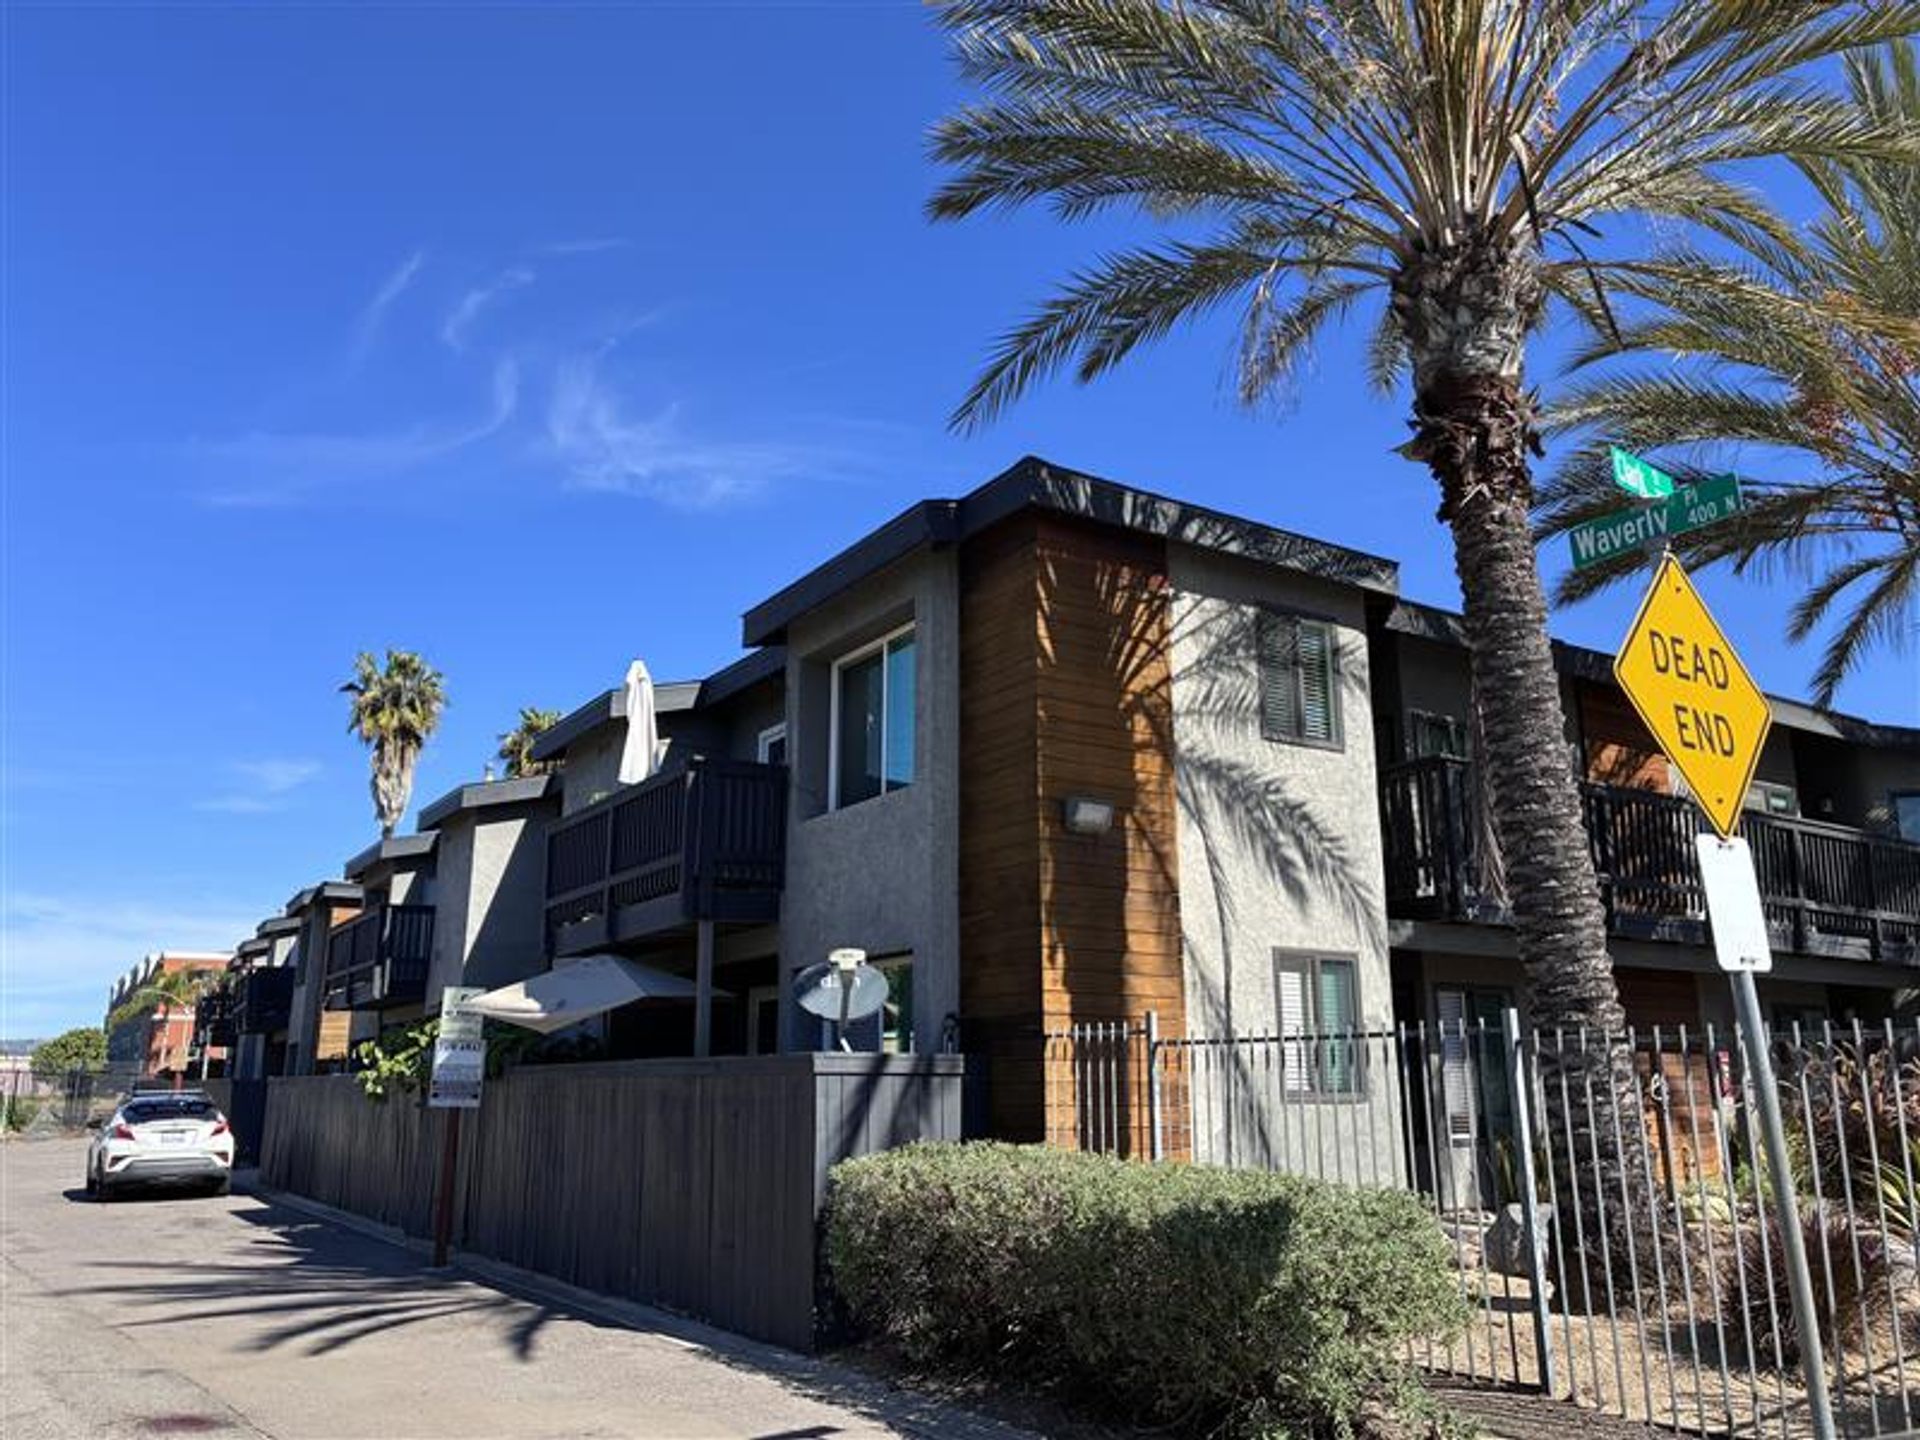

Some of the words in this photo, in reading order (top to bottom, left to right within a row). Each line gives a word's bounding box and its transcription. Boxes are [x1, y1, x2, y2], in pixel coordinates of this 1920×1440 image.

[1574, 507, 1668, 559] Waverly
[1684, 487, 1698, 507] Pl
[1688, 501, 1717, 524] 400
[1724, 494, 1737, 511] N
[1649, 629, 1729, 690] DEAD
[1673, 703, 1734, 757] END
